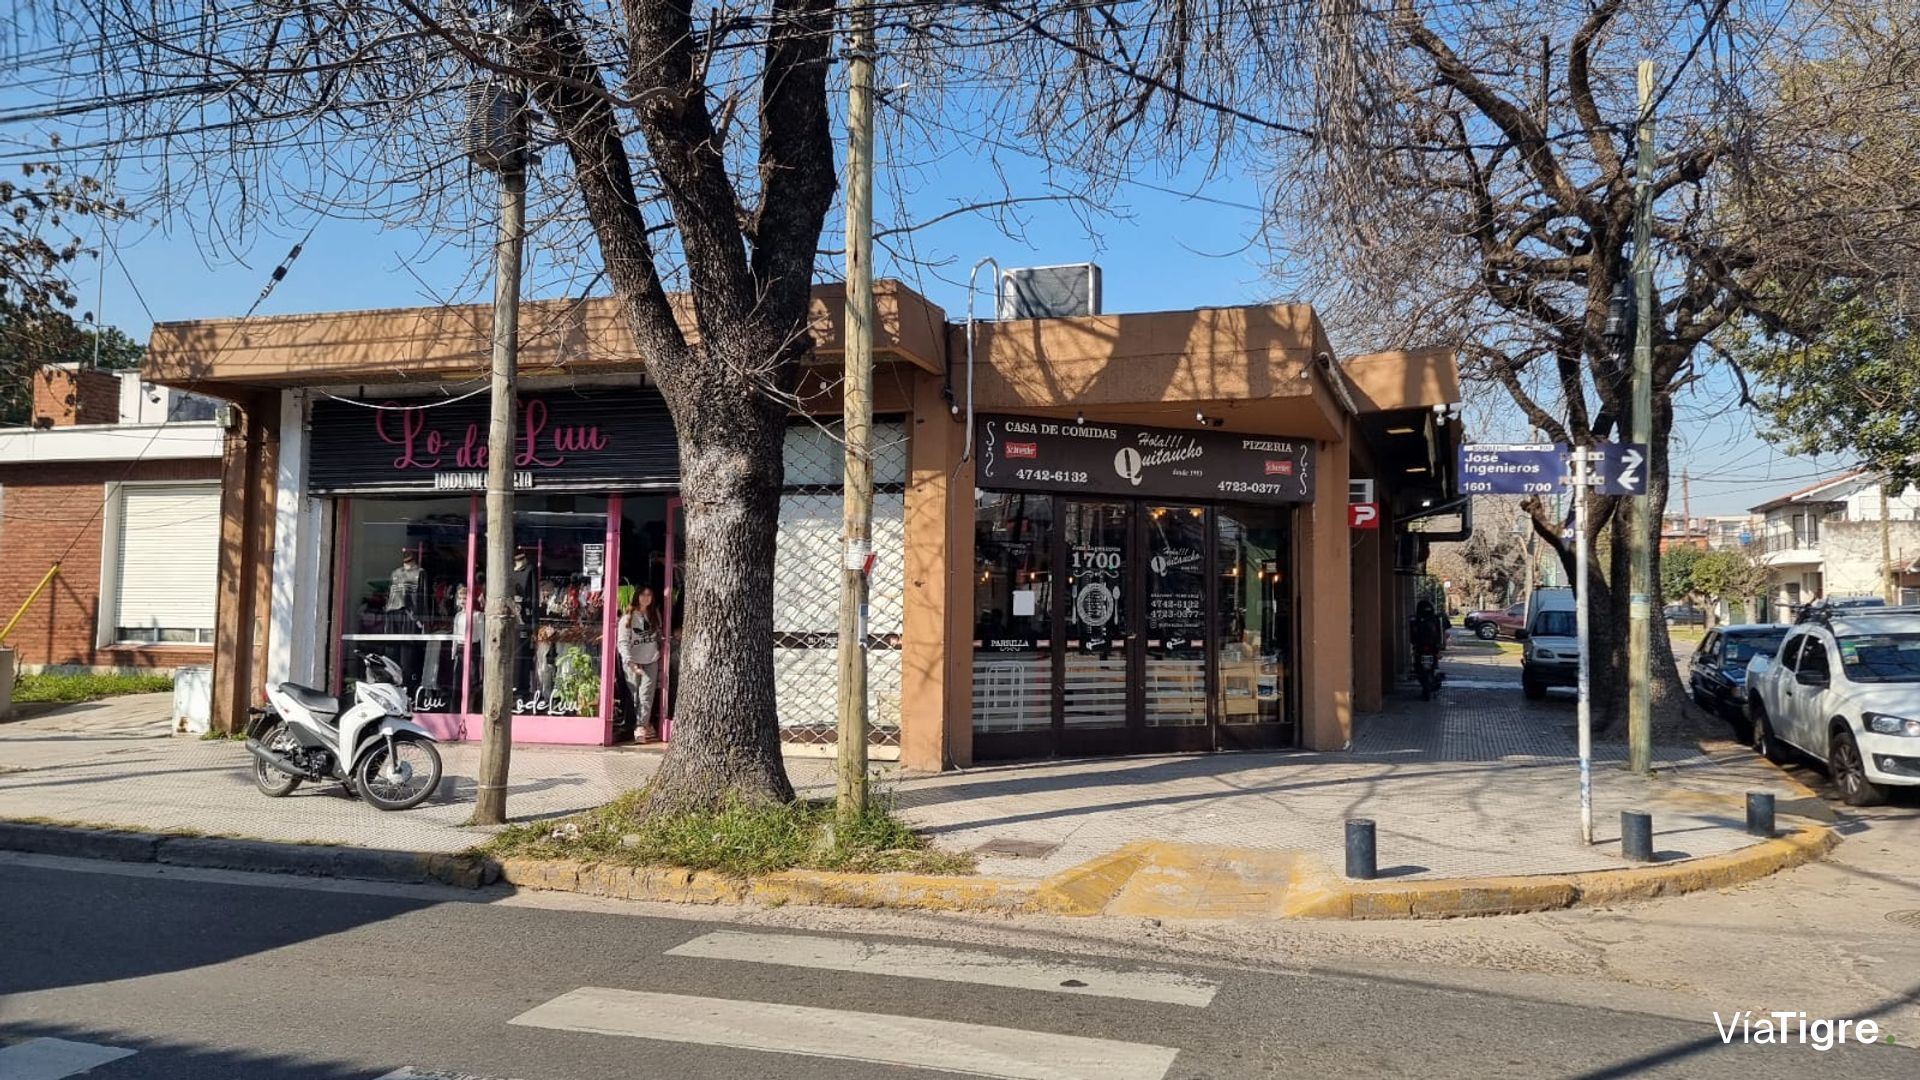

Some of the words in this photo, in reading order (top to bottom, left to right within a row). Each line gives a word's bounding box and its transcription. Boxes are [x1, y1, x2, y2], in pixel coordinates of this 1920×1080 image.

[376, 400, 449, 469] Lo
[456, 423, 489, 468] de
[515, 400, 609, 468] Luu
[1005, 422, 1037, 434] CASA
[1041, 424, 1059, 435] DE
[1062, 426, 1117, 439] COMIDAS
[1137, 432, 1183, 448] Hola!!!
[1242, 440, 1293, 453] PIZZERIA
[1464, 451, 1498, 463] José
[1016, 469, 1088, 483] 4742-6132
[1465, 464, 1540, 475] Ingenieros
[1217, 481, 1280, 494] 4723-0377
[1463, 482, 1491, 491] 1601
[1523, 483, 1552, 492] 1700
[1072, 552, 1121, 569] 1700
